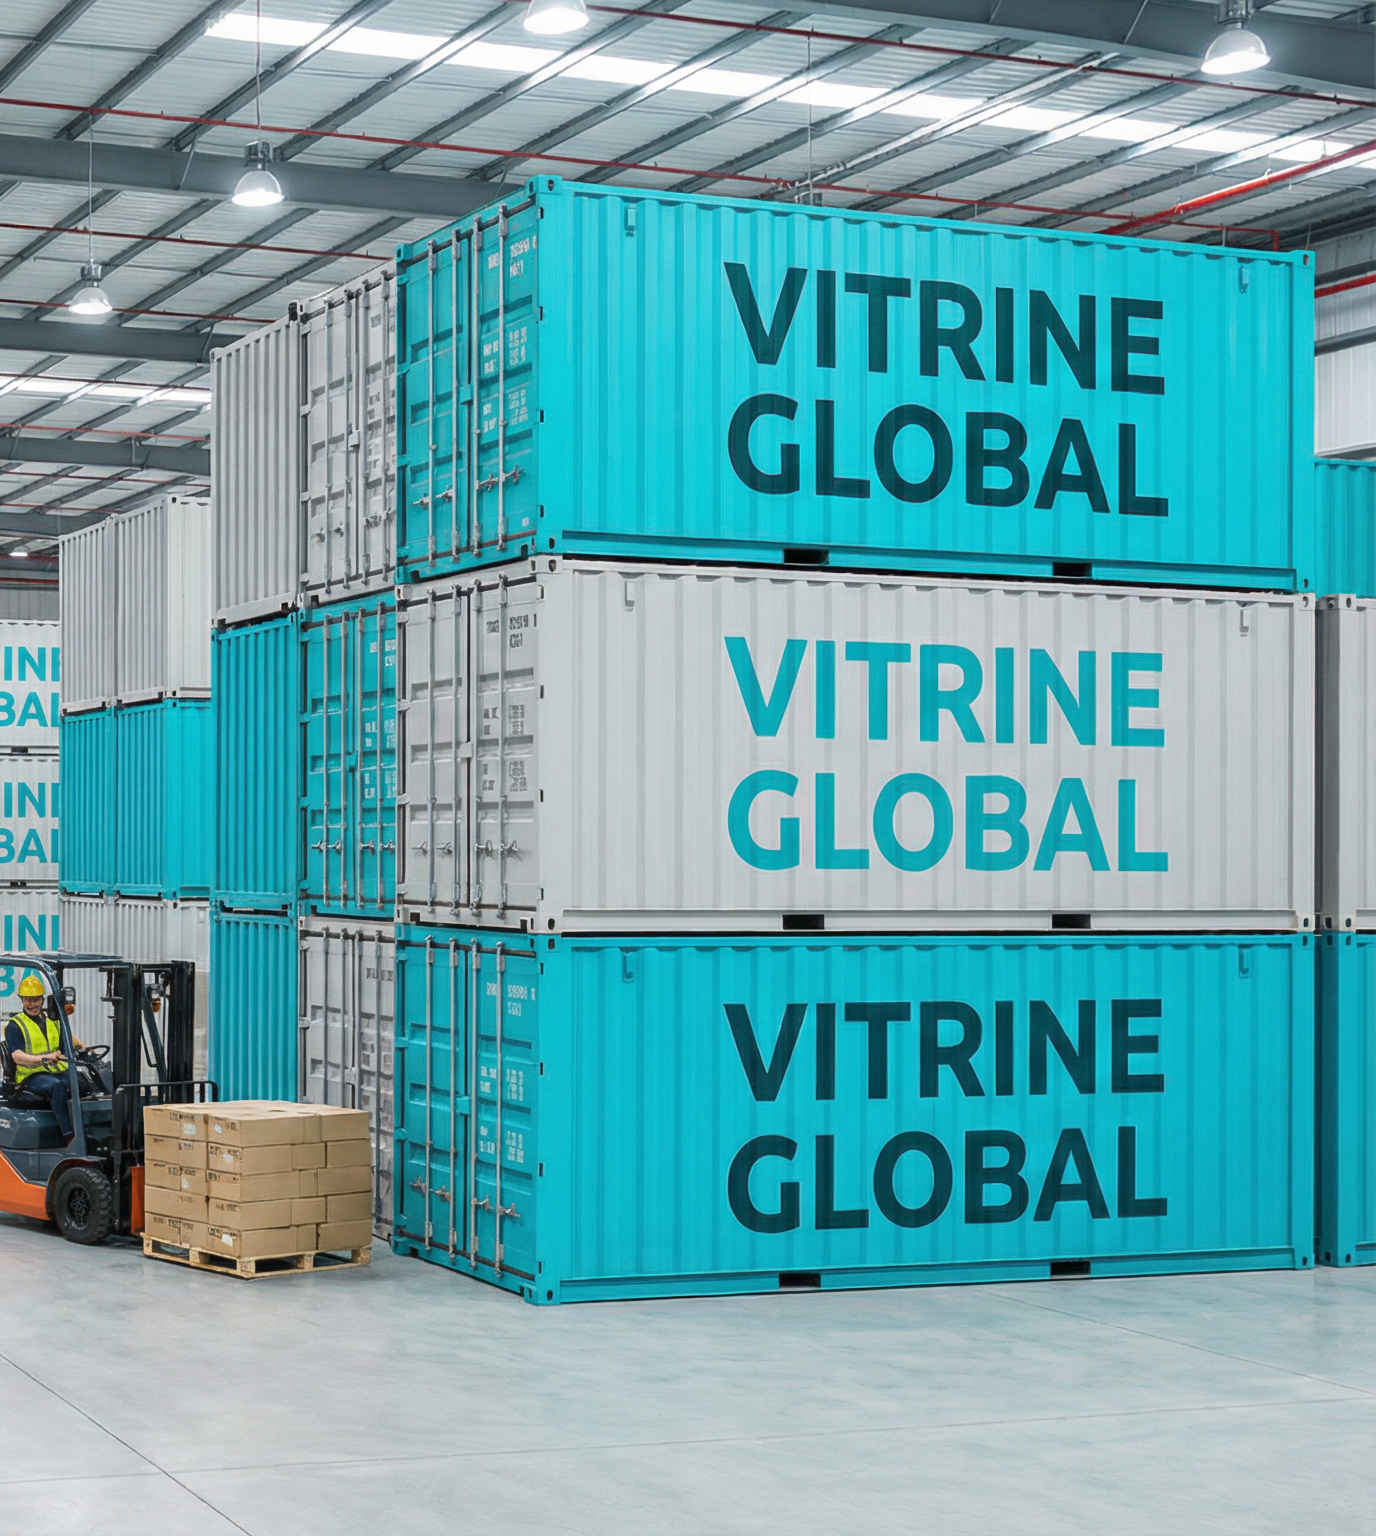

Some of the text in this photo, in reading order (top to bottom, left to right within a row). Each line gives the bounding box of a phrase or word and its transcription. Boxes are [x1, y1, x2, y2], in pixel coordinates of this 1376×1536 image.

[724, 262, 1165, 396] VITRINE
[727, 393, 1169, 517] GLOBAL
[724, 635, 1165, 748] VITRINE
[727, 769, 1169, 873] GLOBAL
[724, 998, 1165, 1102] VITRINE
[727, 1125, 1169, 1235] GLOBAL
